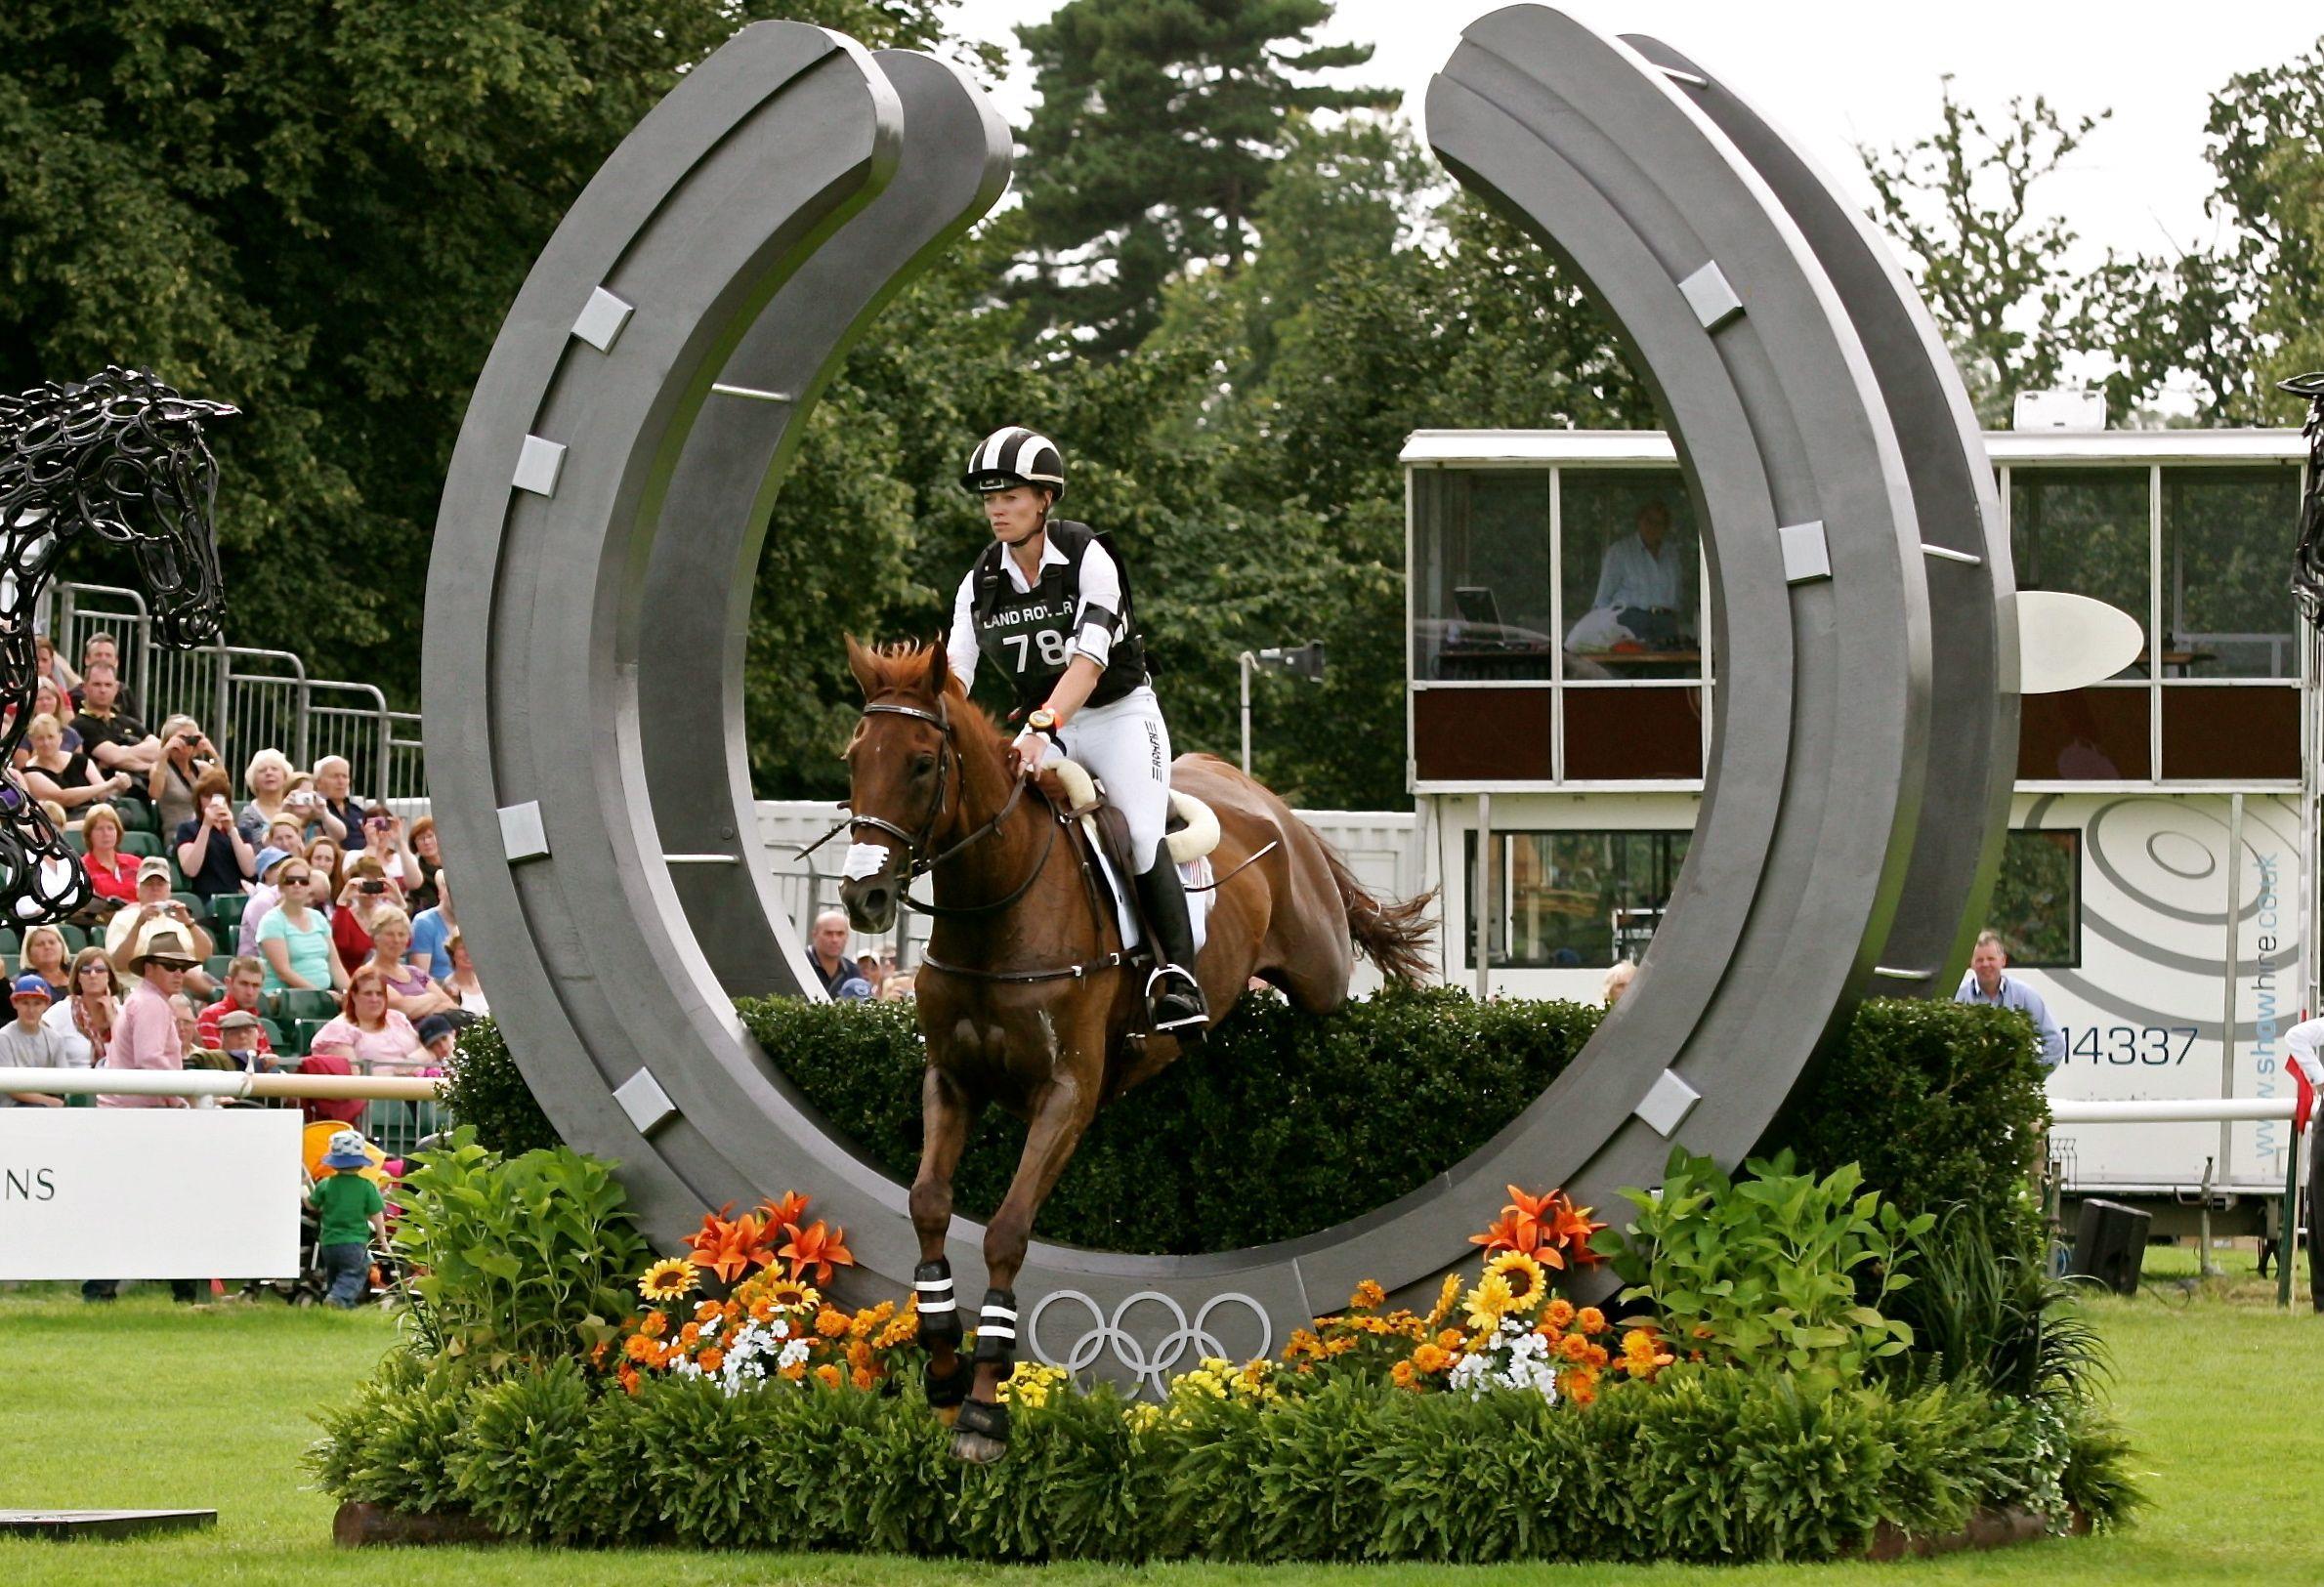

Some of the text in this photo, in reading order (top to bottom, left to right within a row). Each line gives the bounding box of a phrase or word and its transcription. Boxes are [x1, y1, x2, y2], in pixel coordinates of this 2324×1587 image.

[1022, 601, 1074, 621] ROR
[1002, 629, 1067, 674] 78
[6, 1168, 55, 1201] NS
